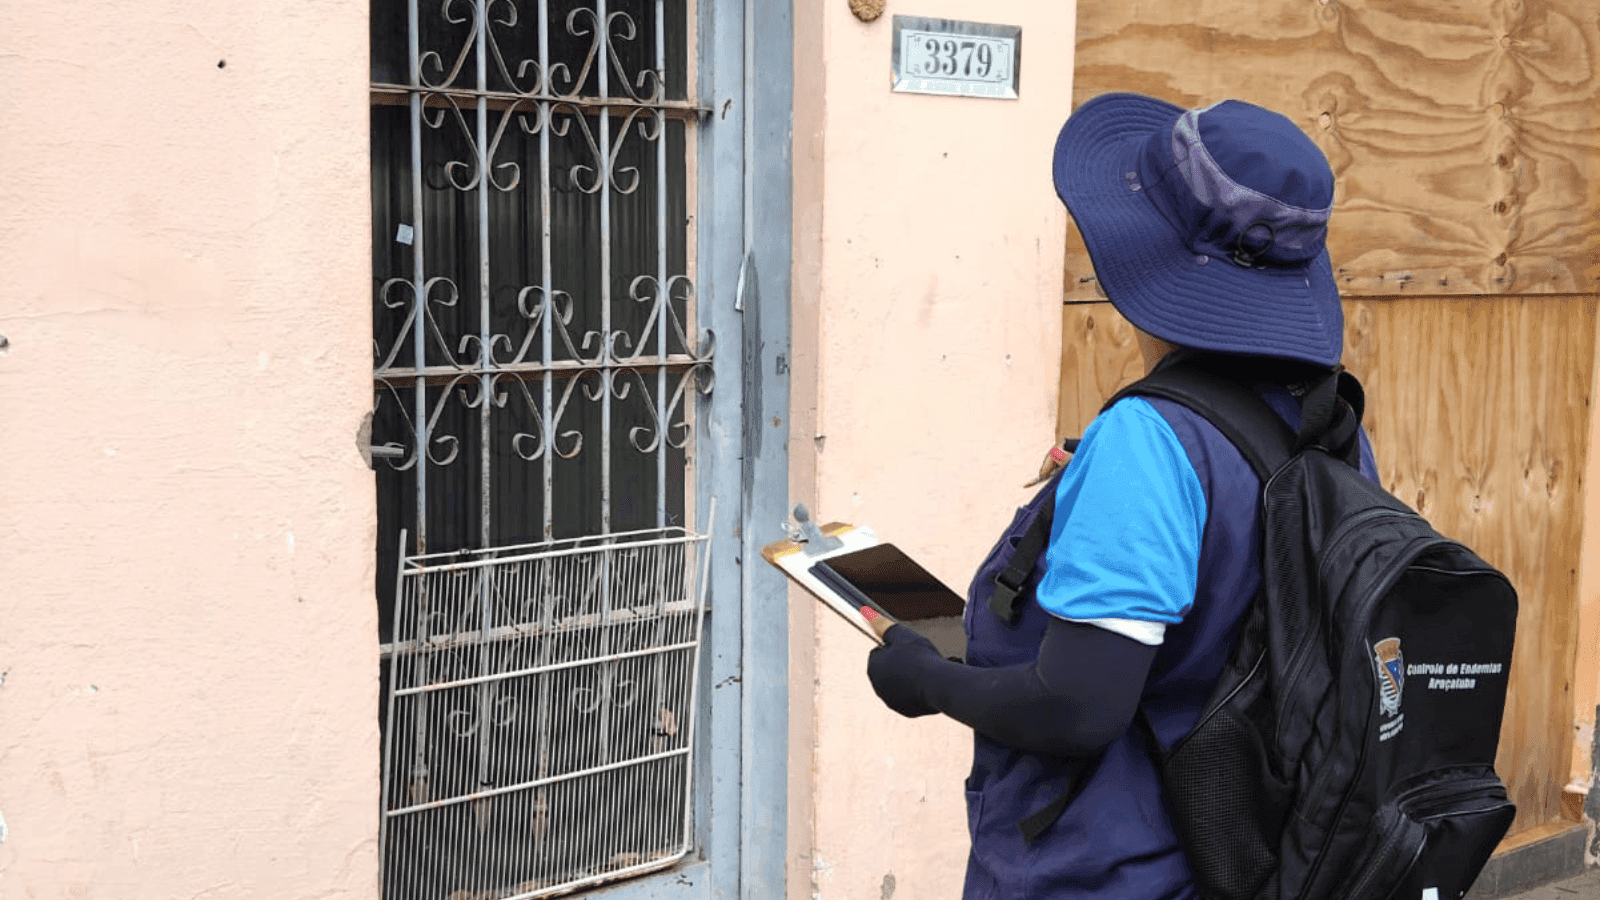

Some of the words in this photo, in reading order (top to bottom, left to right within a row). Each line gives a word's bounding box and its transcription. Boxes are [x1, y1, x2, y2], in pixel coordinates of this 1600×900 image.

[924, 38, 992, 78] 3379
[1407, 663, 1444, 676] Controle
[1446, 663, 1459, 675] de
[1460, 662, 1502, 675] Endemias
